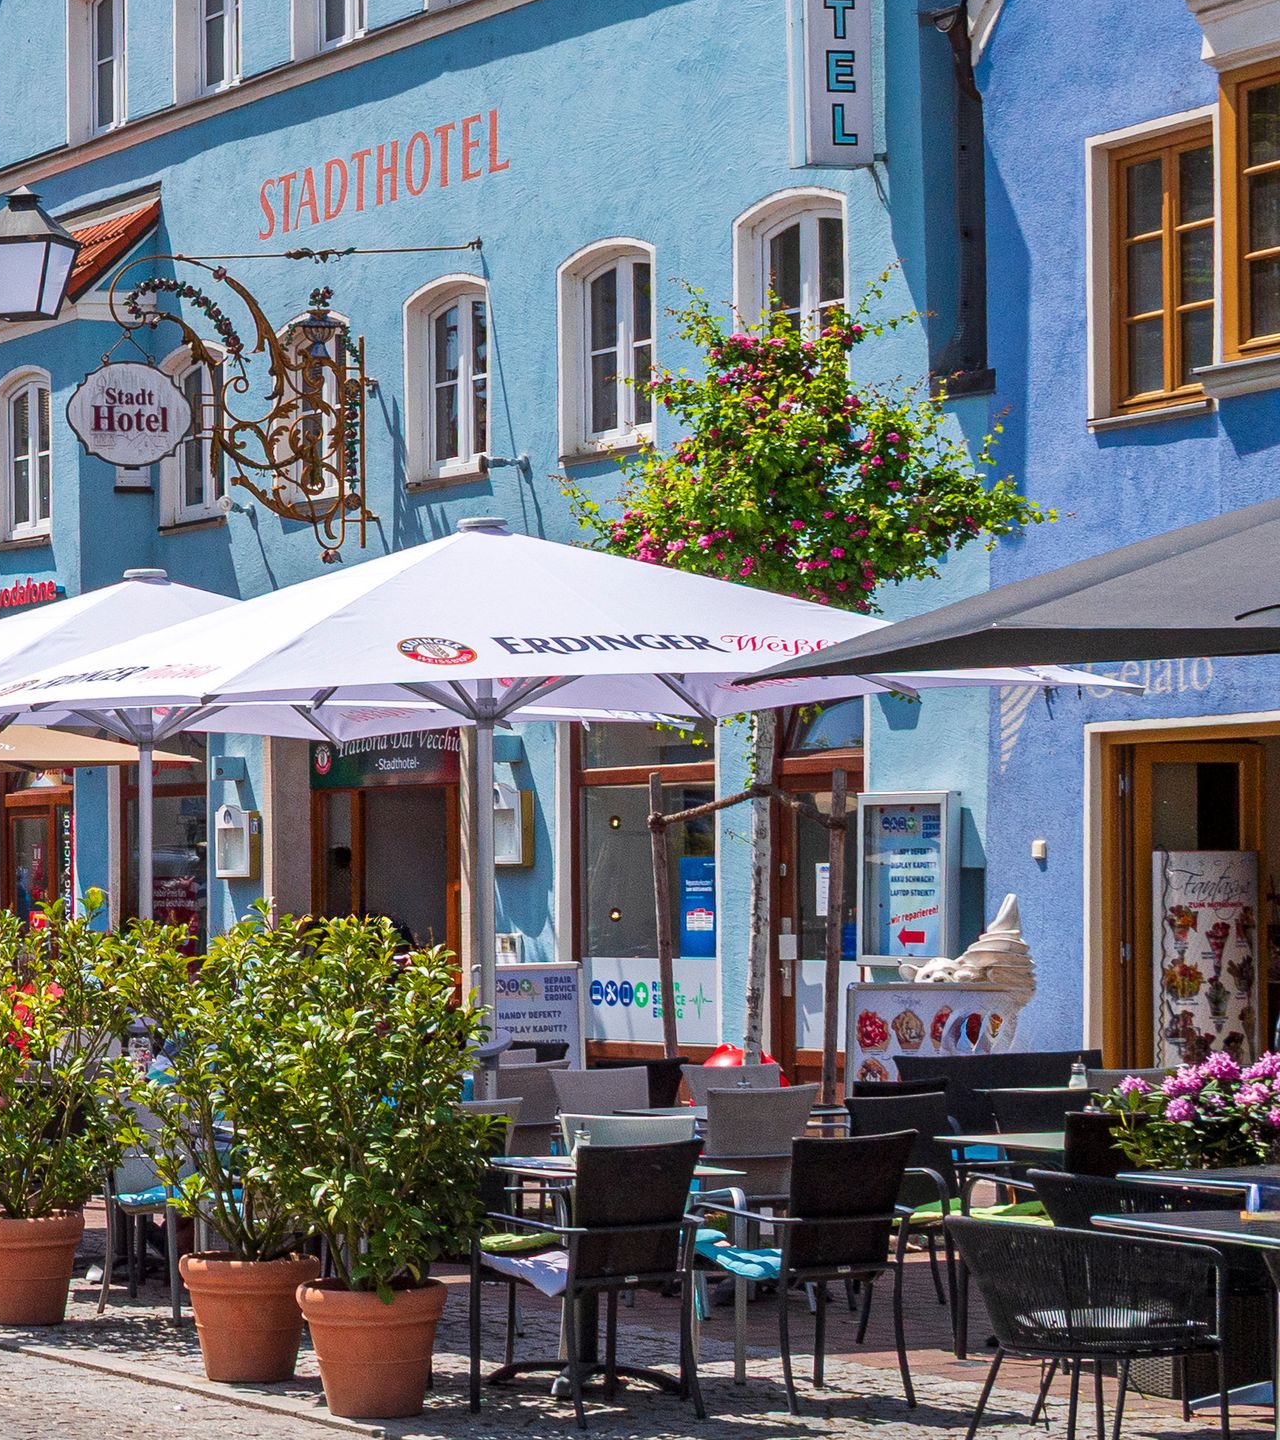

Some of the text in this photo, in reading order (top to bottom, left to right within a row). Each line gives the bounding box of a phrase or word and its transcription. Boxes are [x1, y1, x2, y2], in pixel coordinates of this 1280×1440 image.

[257, 107, 511, 241] STADTHOTEL
[105, 387, 154, 406] Stadt
[91, 405, 169, 433] Hotel
[490, 633, 840, 657] ERDINGER Weißb
[390, 732, 414, 750] Dal
[63, 879, 72, 922] ATUNG
[544, 976, 572, 984] REPAIR
[544, 984, 577, 993] SERVICE
[544, 992, 573, 1001] ERDING
[498, 1010, 562, 1020] HANDY DEFEKT?
[533, 1025, 568, 1033] KAPUTT?
